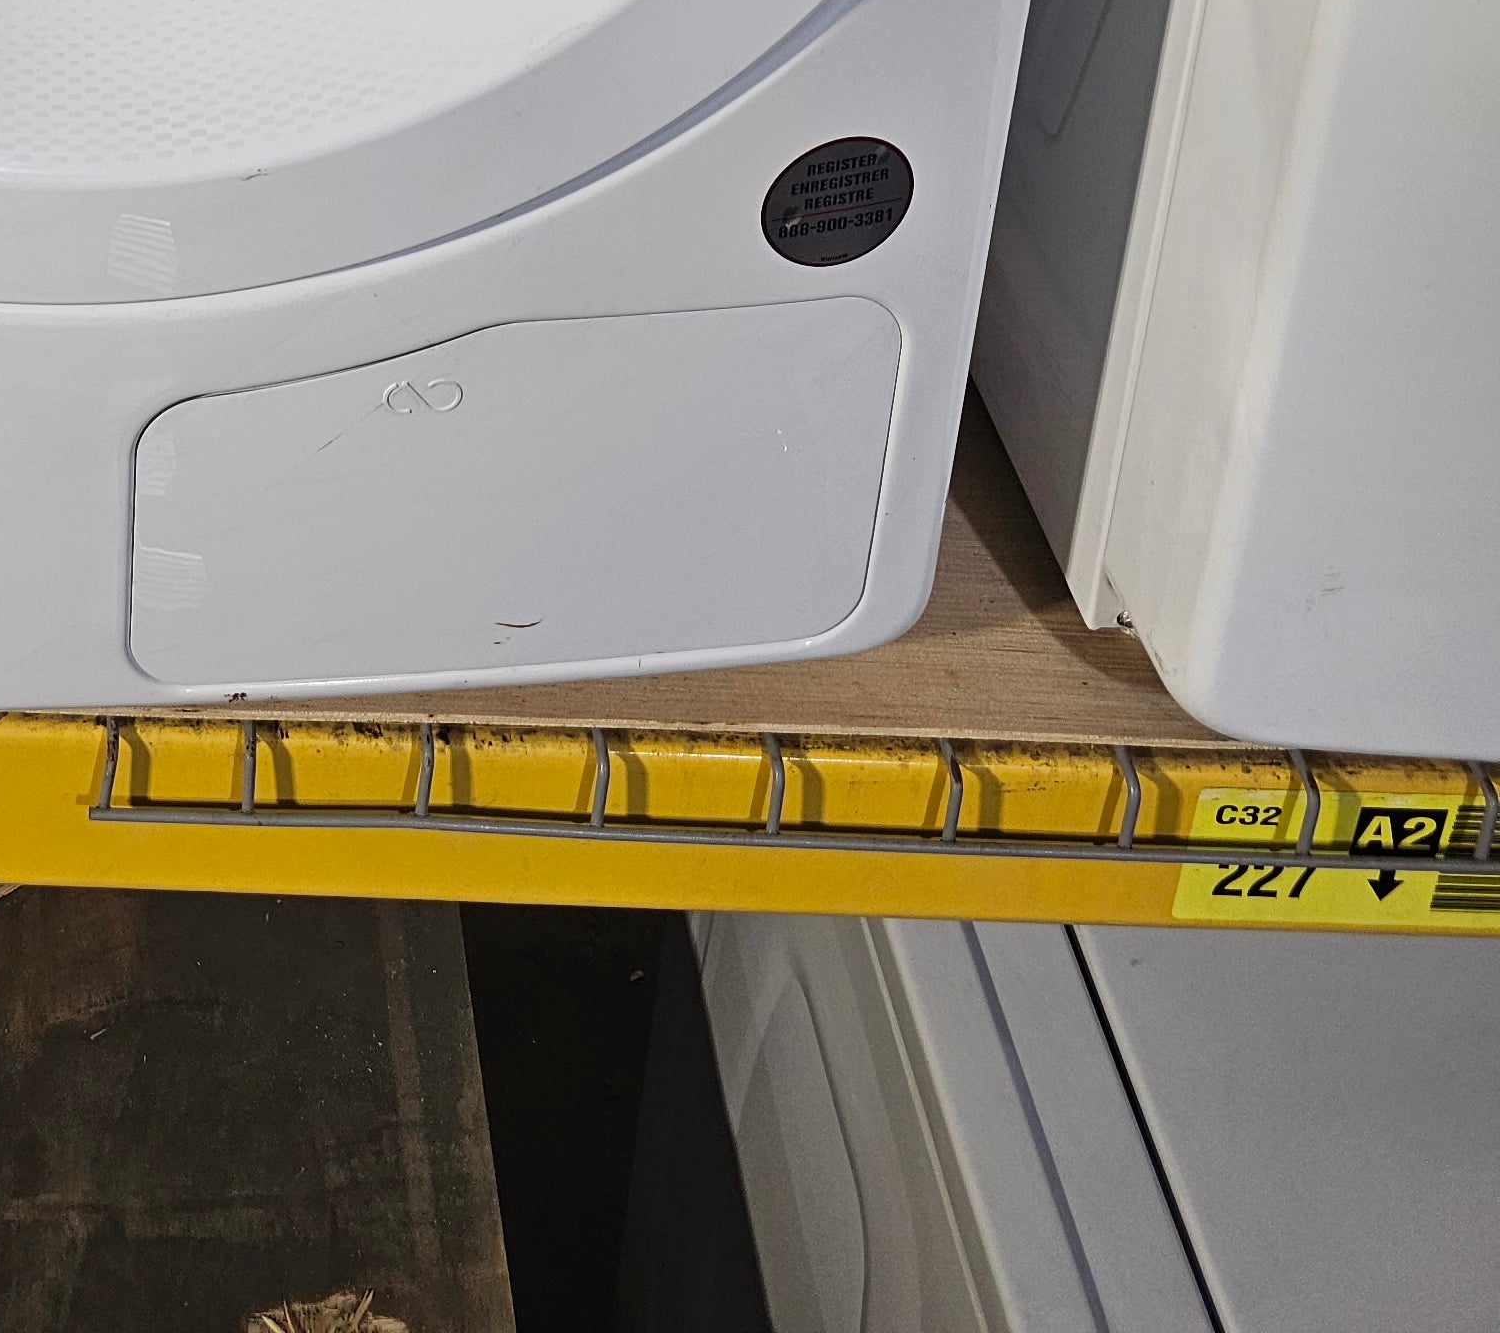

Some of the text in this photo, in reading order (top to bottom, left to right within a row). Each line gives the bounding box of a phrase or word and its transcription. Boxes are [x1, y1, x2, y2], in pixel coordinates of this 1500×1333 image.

[807, 154, 878, 177] REGISTER
[792, 168, 889, 195] ENREGISTRER
[804, 188, 874, 210] REGISTRE
[778, 208, 893, 239] 888-900-3381
[1215, 804, 1282, 826] C32
[1357, 815, 1438, 850] A2
